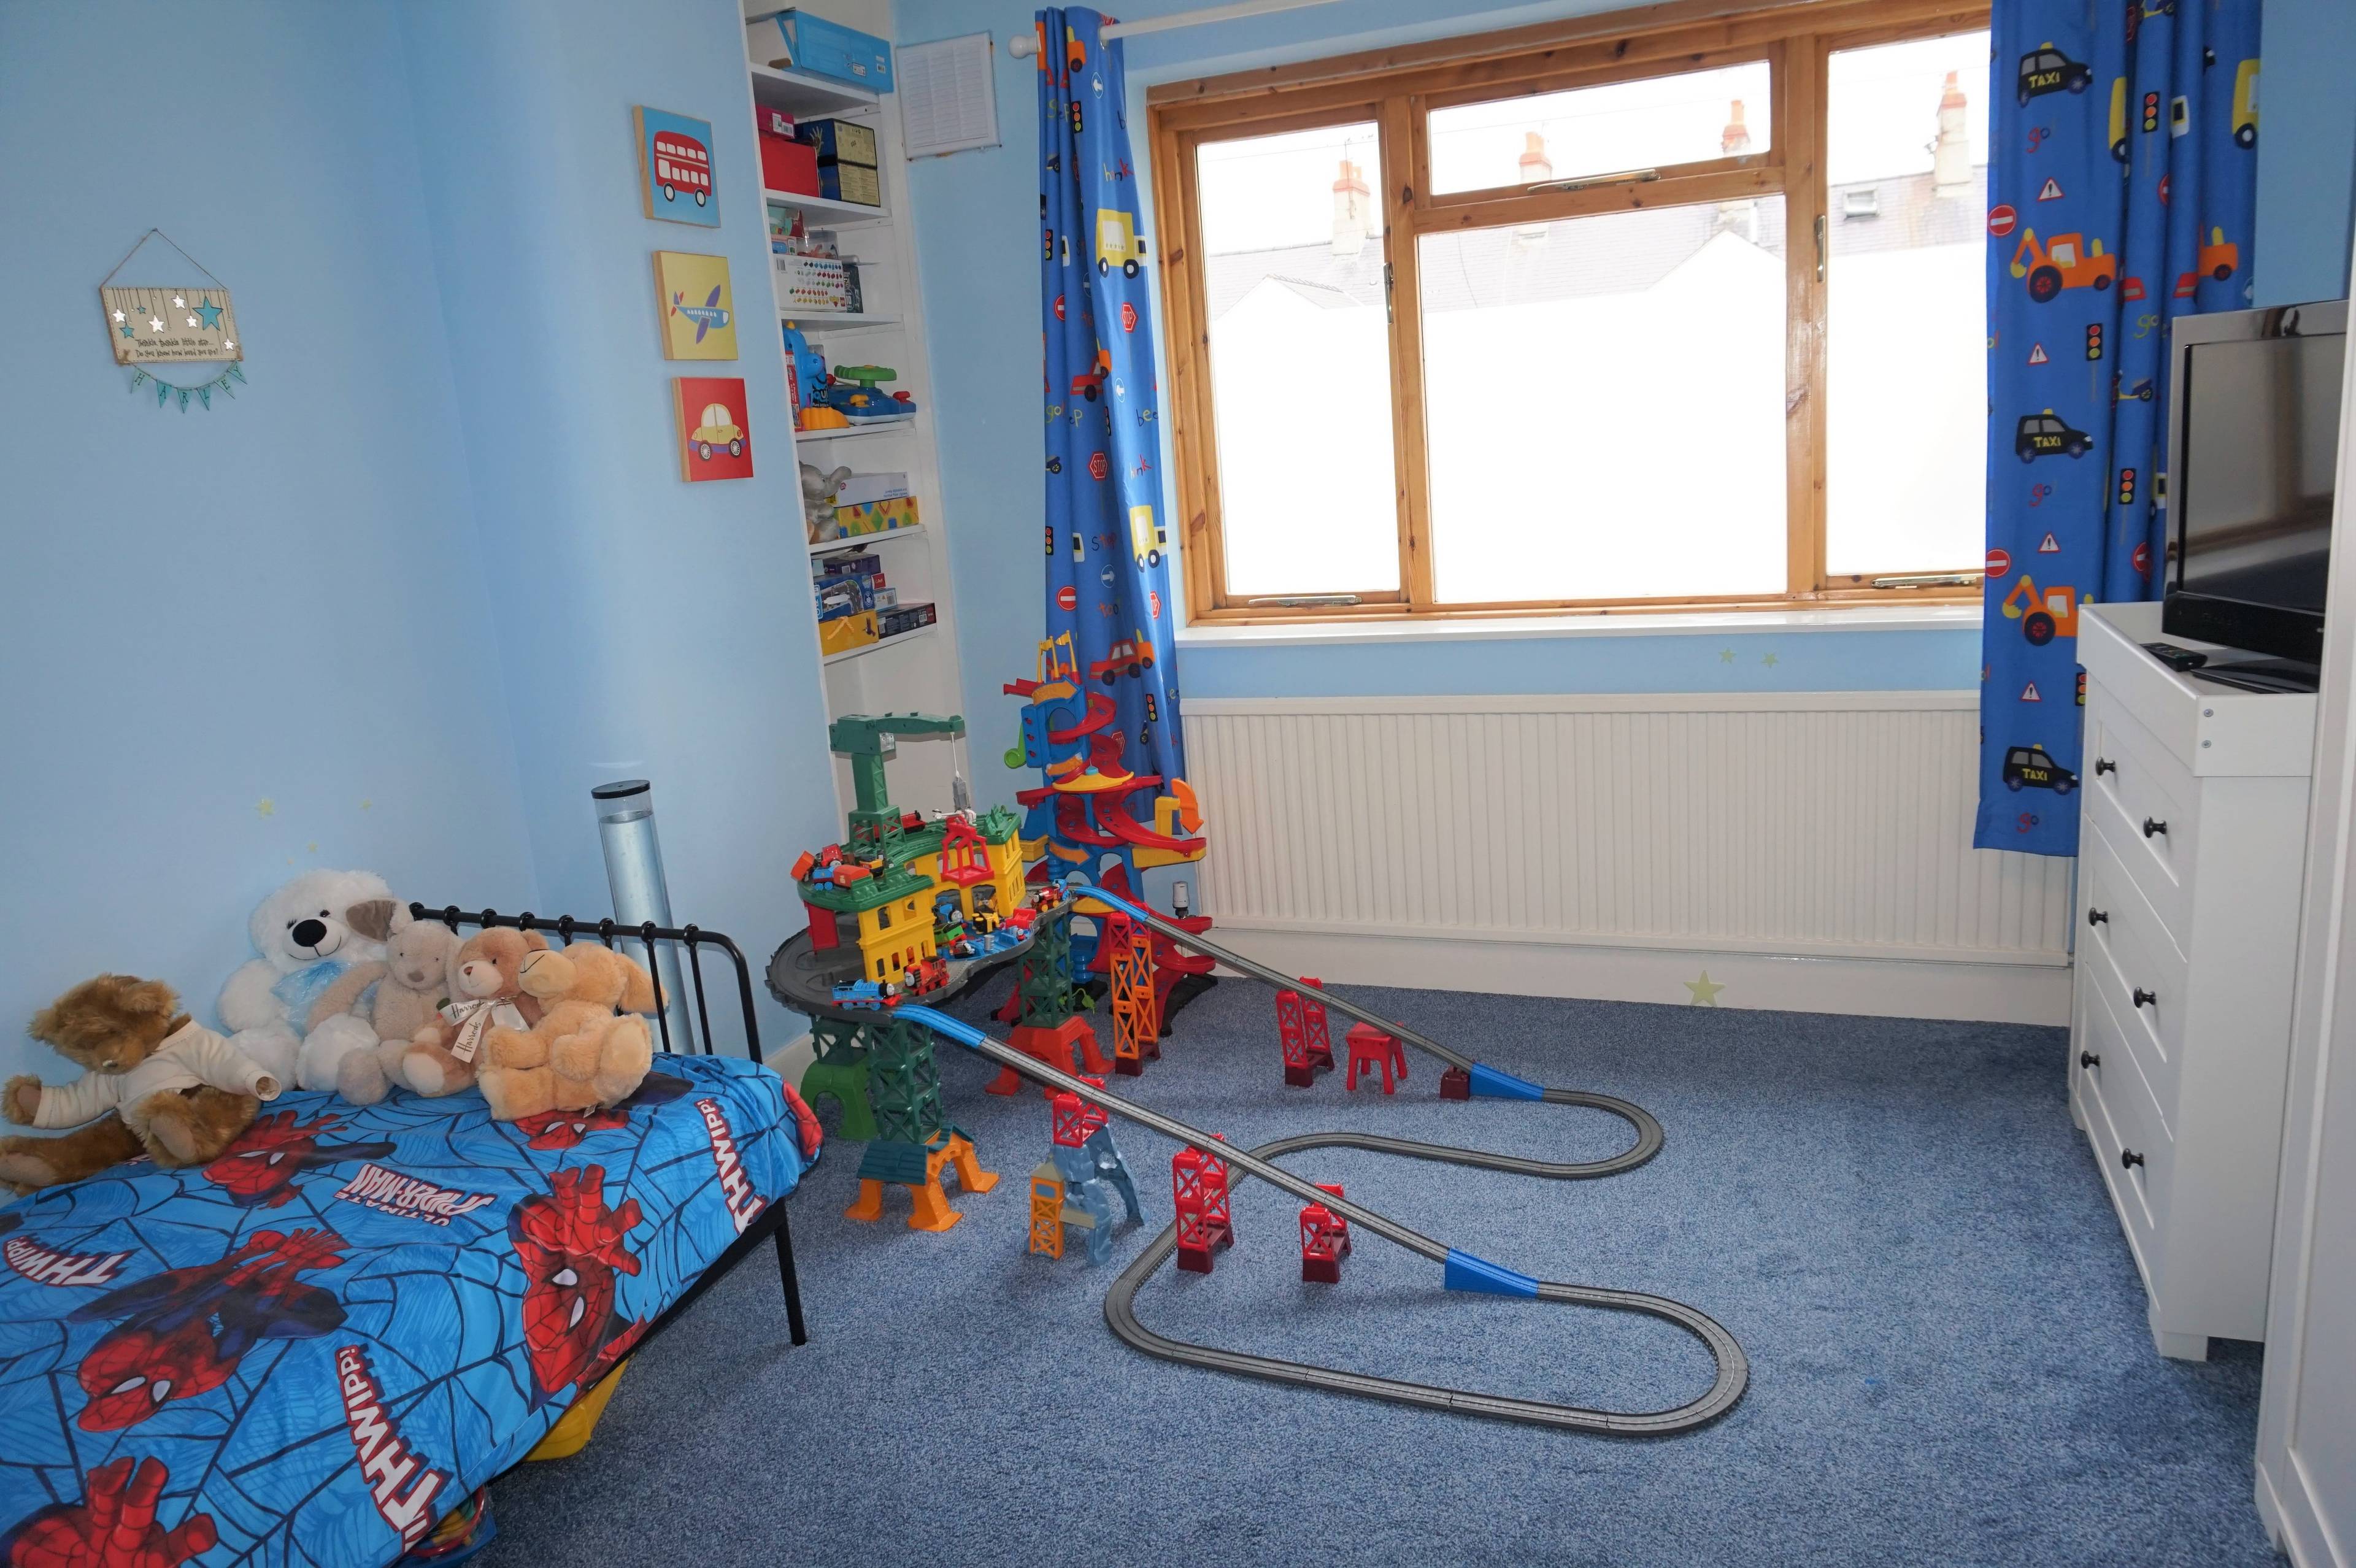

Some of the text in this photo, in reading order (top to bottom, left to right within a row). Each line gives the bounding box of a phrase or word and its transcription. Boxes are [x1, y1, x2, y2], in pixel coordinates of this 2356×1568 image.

[2028, 71, 2061, 89] TAXI
[2033, 436, 2062, 448] TAXI
[1093, 459, 1106, 473] STOP
[2022, 768, 2048, 781] TAXI
[456, 1021, 481, 1055] Harrods
[697, 1098, 763, 1236] THWIPP!
[342, 1163, 496, 1216] SPIDER-MAN
[334, 1191, 450, 1227] ULTIMATE
[6, 1236, 126, 1286] THWIPP!
[339, 1348, 440, 1532] THWIPP!
